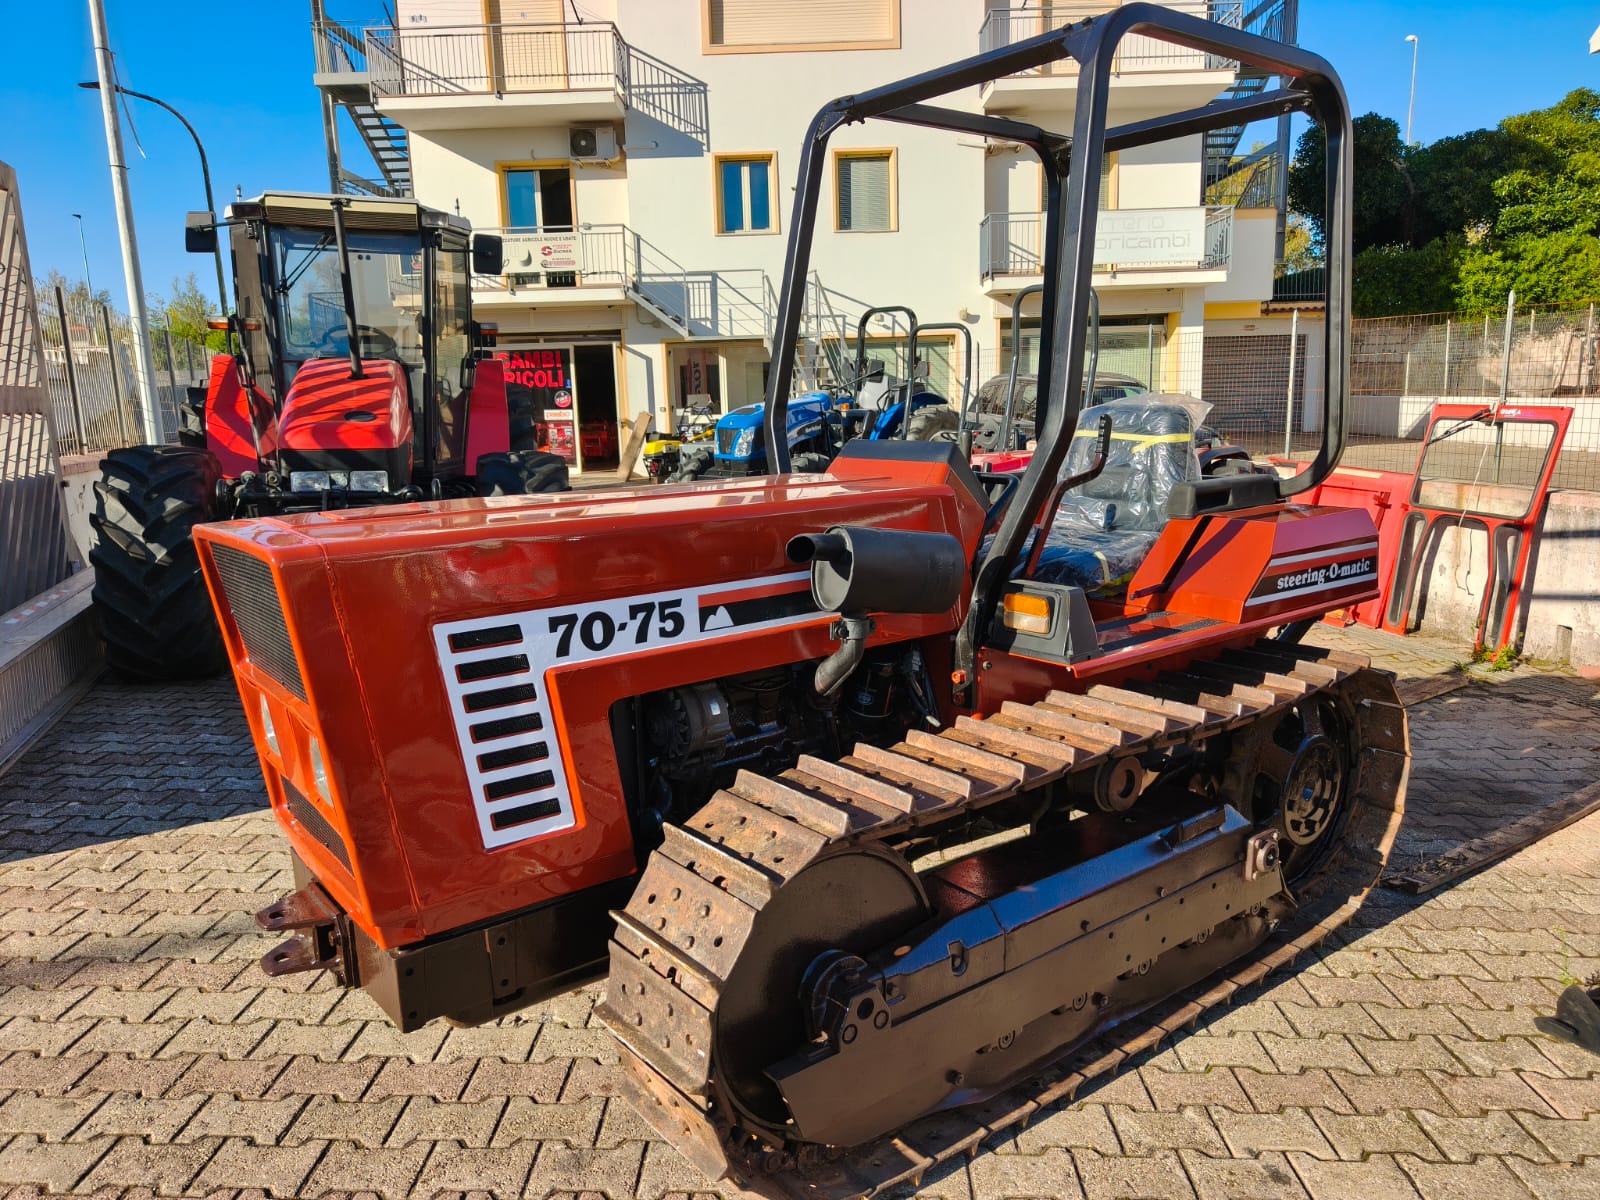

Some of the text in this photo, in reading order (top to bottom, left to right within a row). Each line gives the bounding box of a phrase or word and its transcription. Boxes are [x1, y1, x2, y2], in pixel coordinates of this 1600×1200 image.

[498, 350, 562, 369] CAMBI
[504, 369, 564, 388] RICOLI
[548, 597, 685, 658] 70-75
